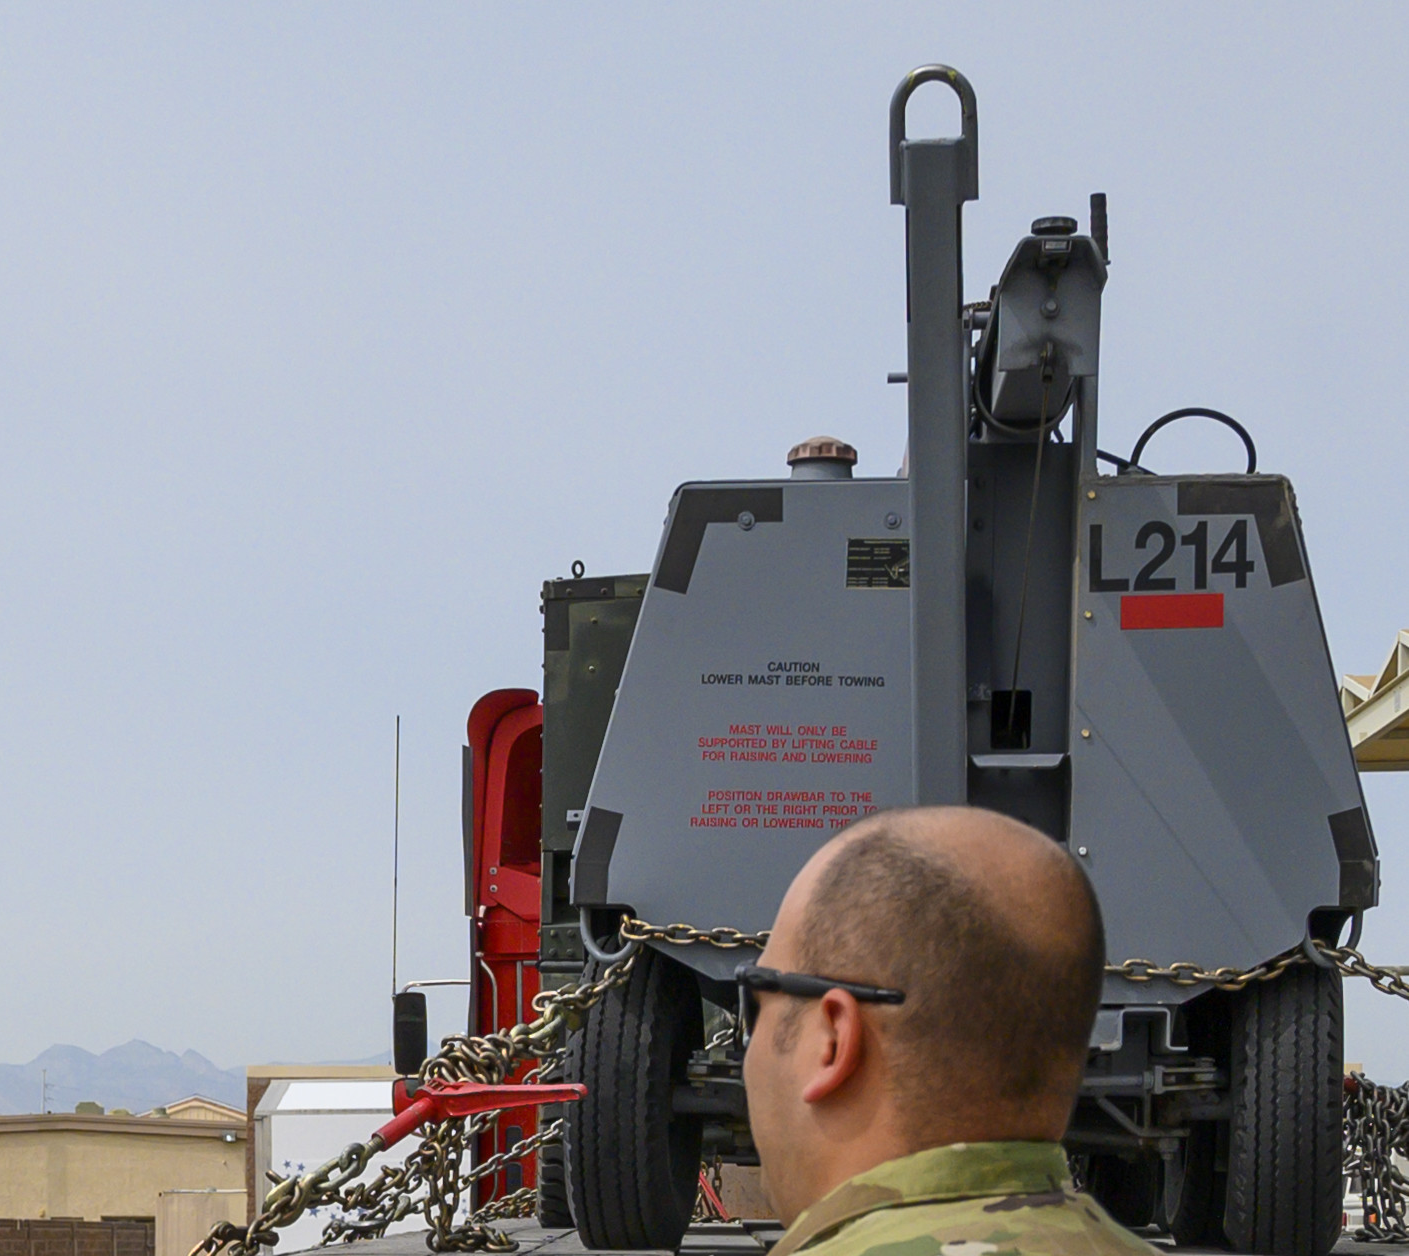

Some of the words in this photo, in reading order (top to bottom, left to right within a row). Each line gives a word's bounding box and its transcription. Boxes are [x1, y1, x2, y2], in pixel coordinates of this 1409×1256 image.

[1089, 520, 1255, 592] L214
[767, 661, 820, 673] CAUTION
[701, 674, 743, 685] LOWER
[748, 674, 781, 686] MAST
[785, 675, 833, 687] BEFORE
[838, 676, 885, 688] TOWING
[729, 724, 762, 736] MAST
[766, 725, 792, 736] WILL
[797, 725, 827, 736] ONLY
[832, 726, 847, 737] BE
[697, 737, 767, 749] SUPPORTED
[772, 738, 787, 749] BY
[792, 738, 835, 750] LIFTING
[840, 739, 878, 751] CABLE
[702, 750, 725, 761] FOR
[730, 751, 777, 762] RAISING
[781, 751, 807, 763] AND
[811, 752, 873, 764] LOWERING
[708, 790, 762, 802] POSITION
[766, 790, 825, 802] DRAWBAR
[830, 791, 846, 802] TO
[850, 791, 873, 803] THE
[701, 803, 730, 815] LEFT
[734, 804, 751, 815] OR
[756, 804, 778, 815] THE
[783, 804, 818, 816] RIGHT
[822, 805, 858, 816] PRIOR
[690, 817, 737, 828] RAISING
[742, 817, 759, 828] OR
[763, 818, 824, 829] LOWERING
